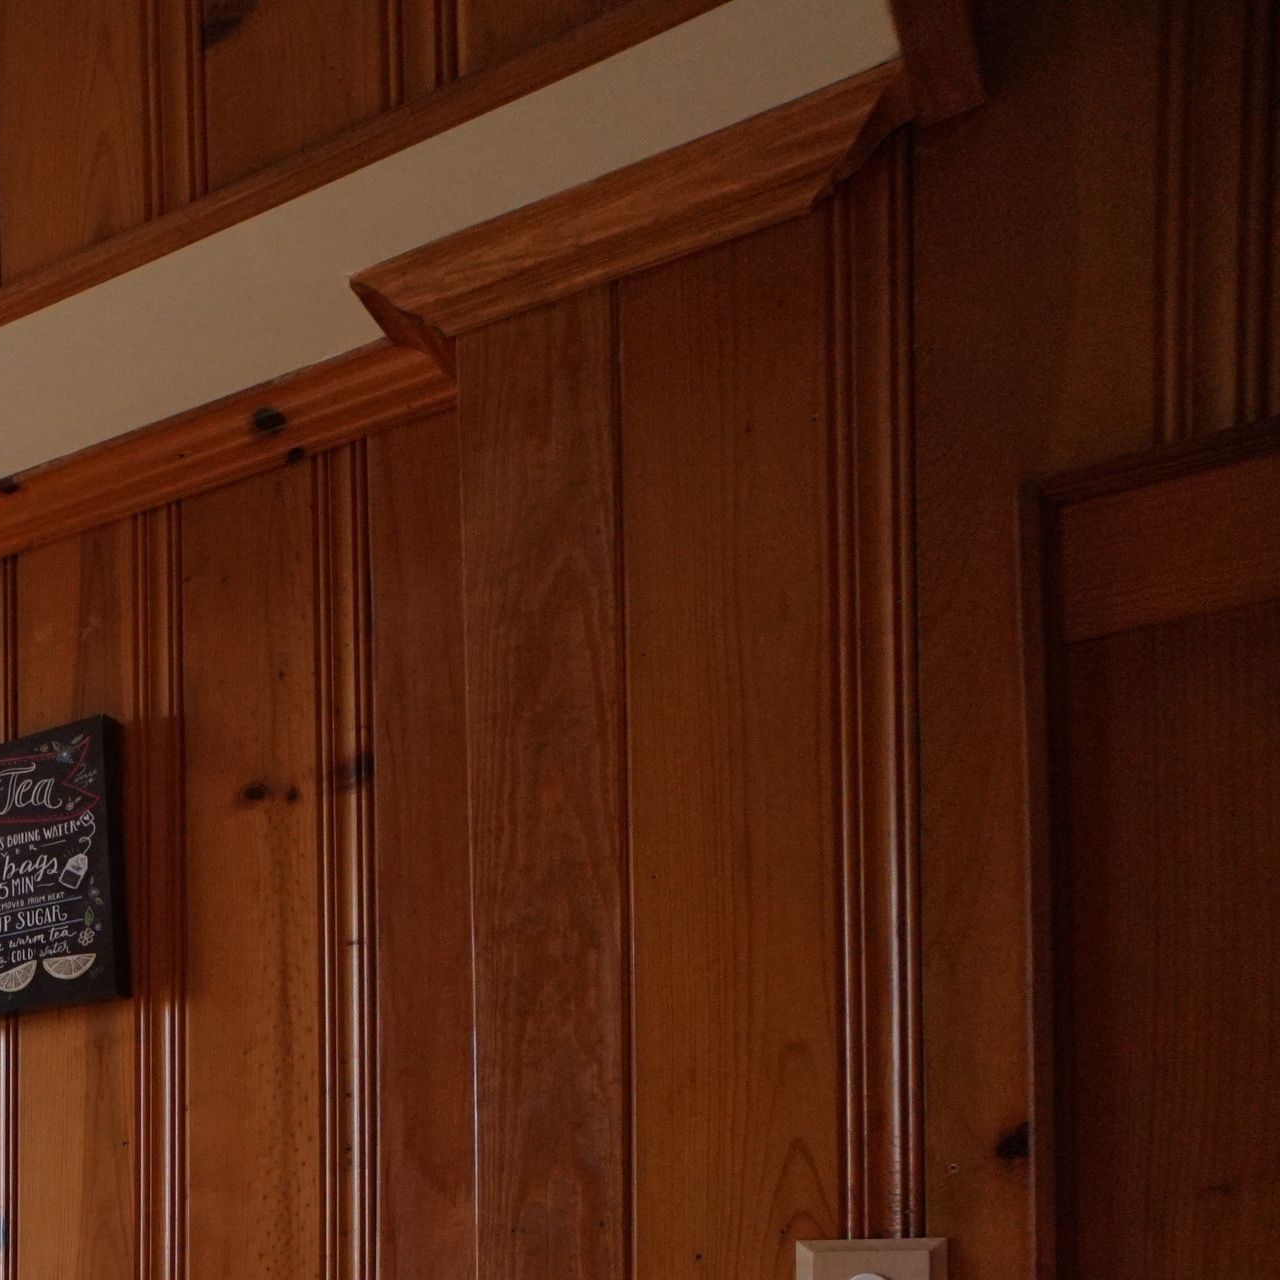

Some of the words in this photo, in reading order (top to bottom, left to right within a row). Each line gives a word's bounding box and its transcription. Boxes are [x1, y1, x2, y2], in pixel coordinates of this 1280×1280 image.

[6, 828, 40, 848] BOILING
[2, 855, 59, 882] bags
[0, 882, 9, 900] 5
[11, 875, 34, 897] MIN
[27, 894, 46, 905] FROM
[15, 904, 68, 930] SUGAR
[9, 932, 47, 949] warm
[49, 926, 77, 941] tea
[11, 949, 34, 963] COLD
